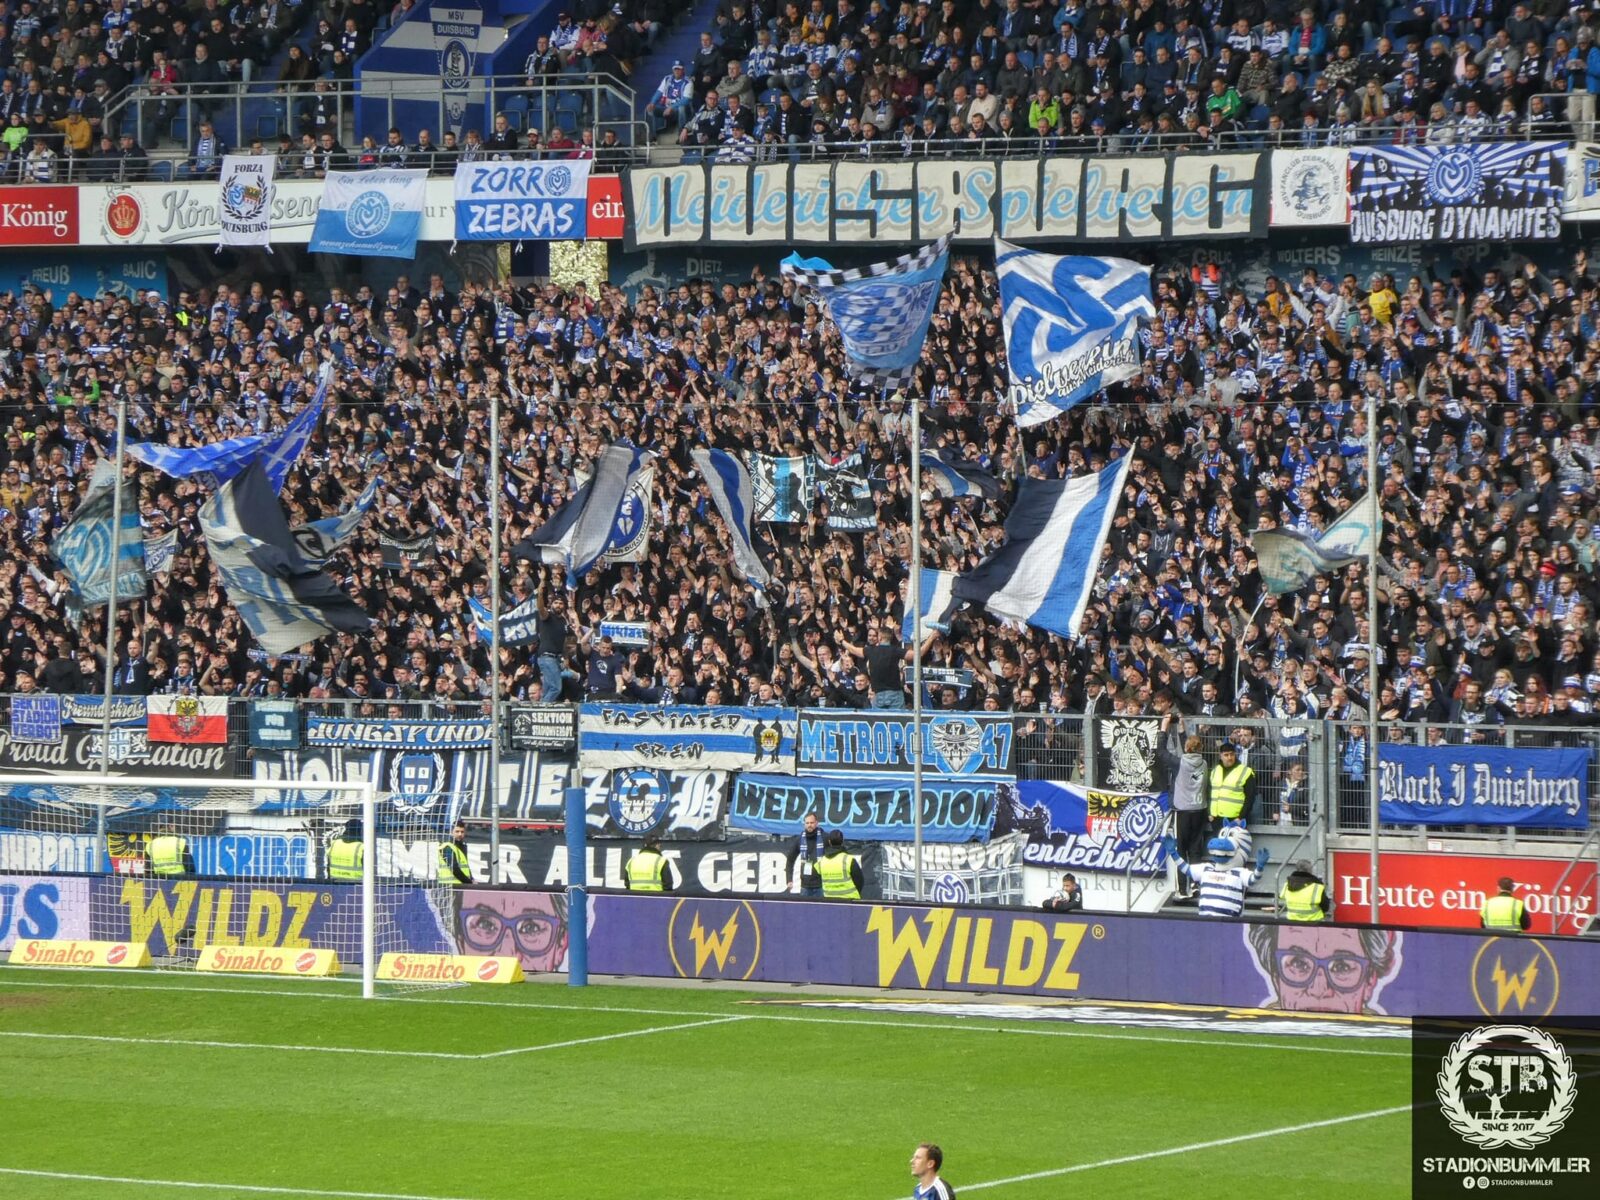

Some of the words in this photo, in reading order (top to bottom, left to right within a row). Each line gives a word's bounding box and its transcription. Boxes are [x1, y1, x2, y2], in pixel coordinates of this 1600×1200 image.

[448, 11, 464, 20] MSV
[437, 24, 475, 36] DUISBURG
[235, 163, 263, 173] FORZA
[1, 203, 68, 237] König
[468, 203, 573, 236] ZEBRAS
[1351, 207, 1436, 242] DUISBURG
[1441, 205, 1561, 240] DYNAMITES
[1277, 246, 1341, 265] WOLTERS
[1371, 246, 1421, 263] HEINZE
[123, 260, 157, 280] BAJIC
[686, 257, 722, 277] DIETZ
[12, 696, 58, 709] SEKTION
[12, 710, 60, 723] STADION
[531, 712, 573, 724] SEKTION
[12, 724, 60, 739] VERBOT
[980, 722, 1013, 770] 47
[1378, 760, 1443, 806] Block
[1472, 762, 1582, 817] Duisburg
[734, 779, 997, 830] WEDAUSTADION
[1341, 875, 1434, 909] Heute
[1440, 881, 1487, 910] ein
[119, 879, 318, 956] WILDZ
[23, 941, 95, 964] Sinalco
[865, 905, 1089, 990] WILDZ
[211, 949, 284, 971] Sinalco
[390, 955, 465, 980] Sinalco
